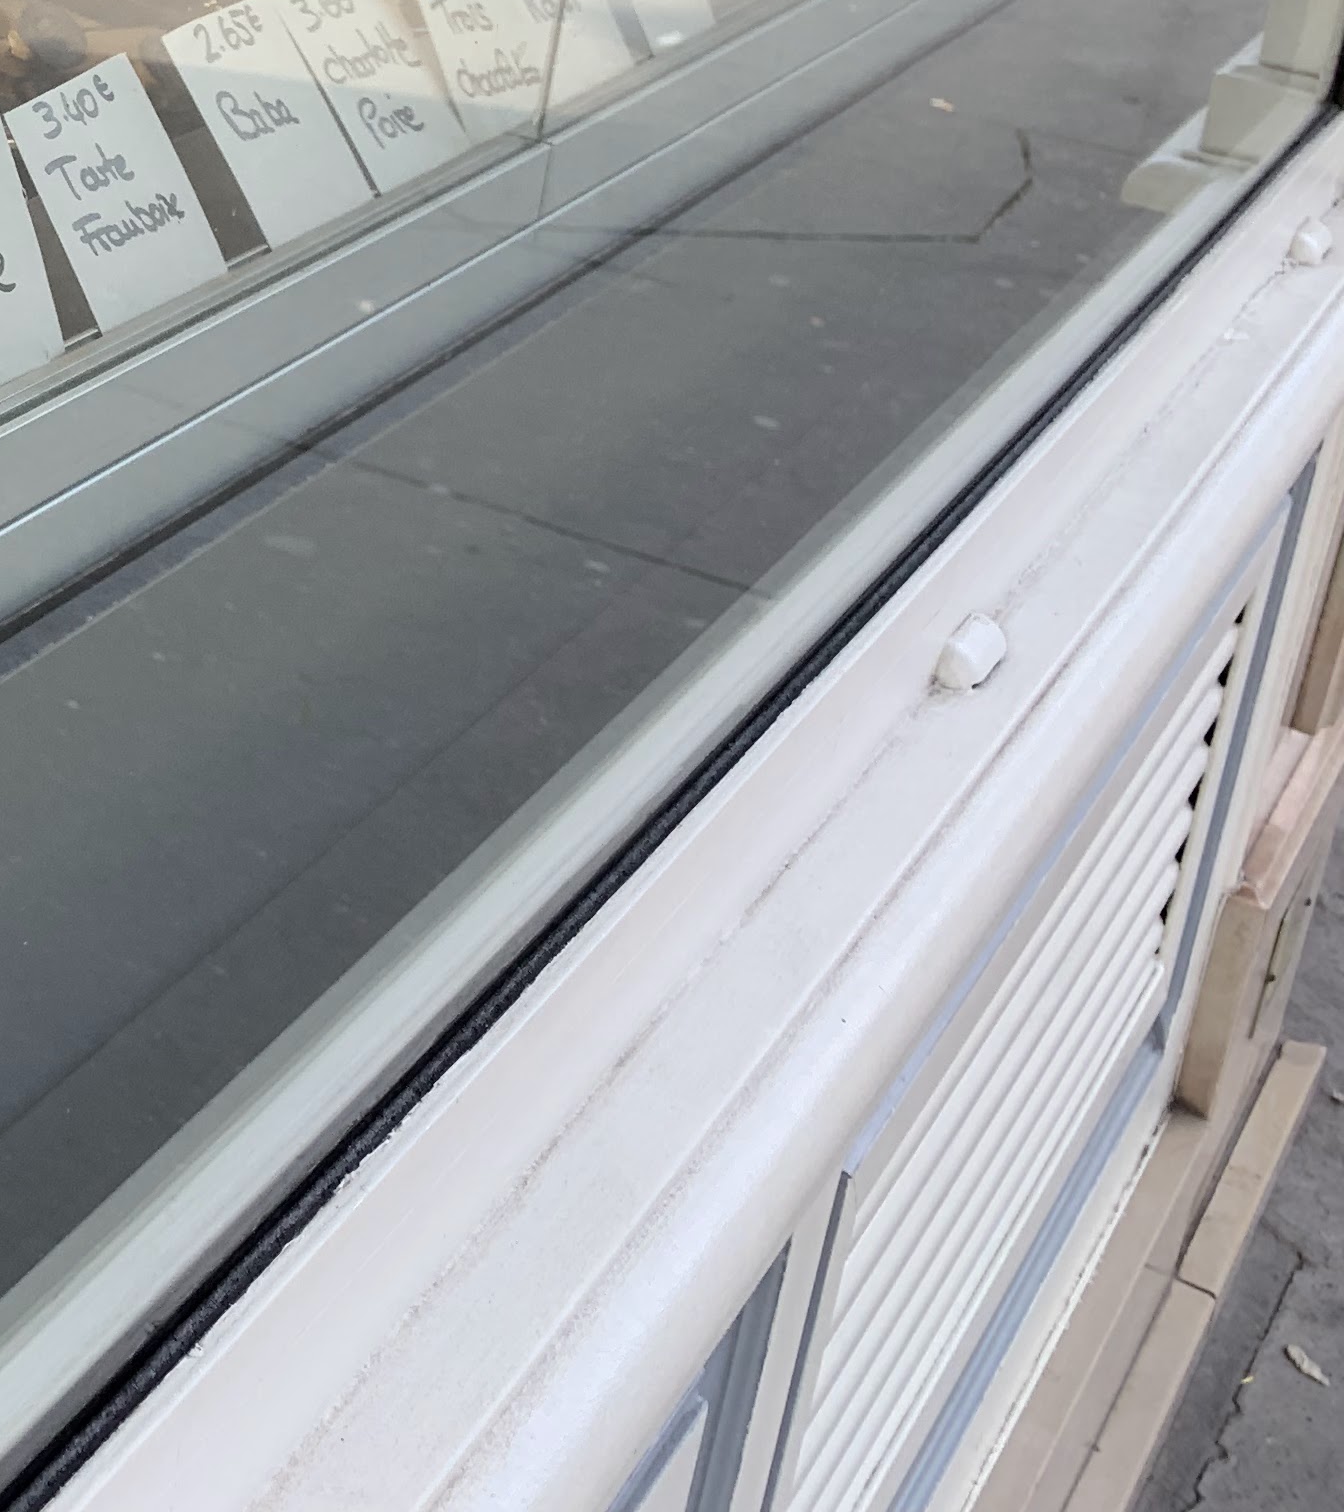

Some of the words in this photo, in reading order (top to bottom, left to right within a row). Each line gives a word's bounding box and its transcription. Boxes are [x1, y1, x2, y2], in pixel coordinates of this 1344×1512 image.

[215, 90, 301, 142] Baba
[357, 92, 426, 150] Poire
[44, 141, 136, 202] Tarte
